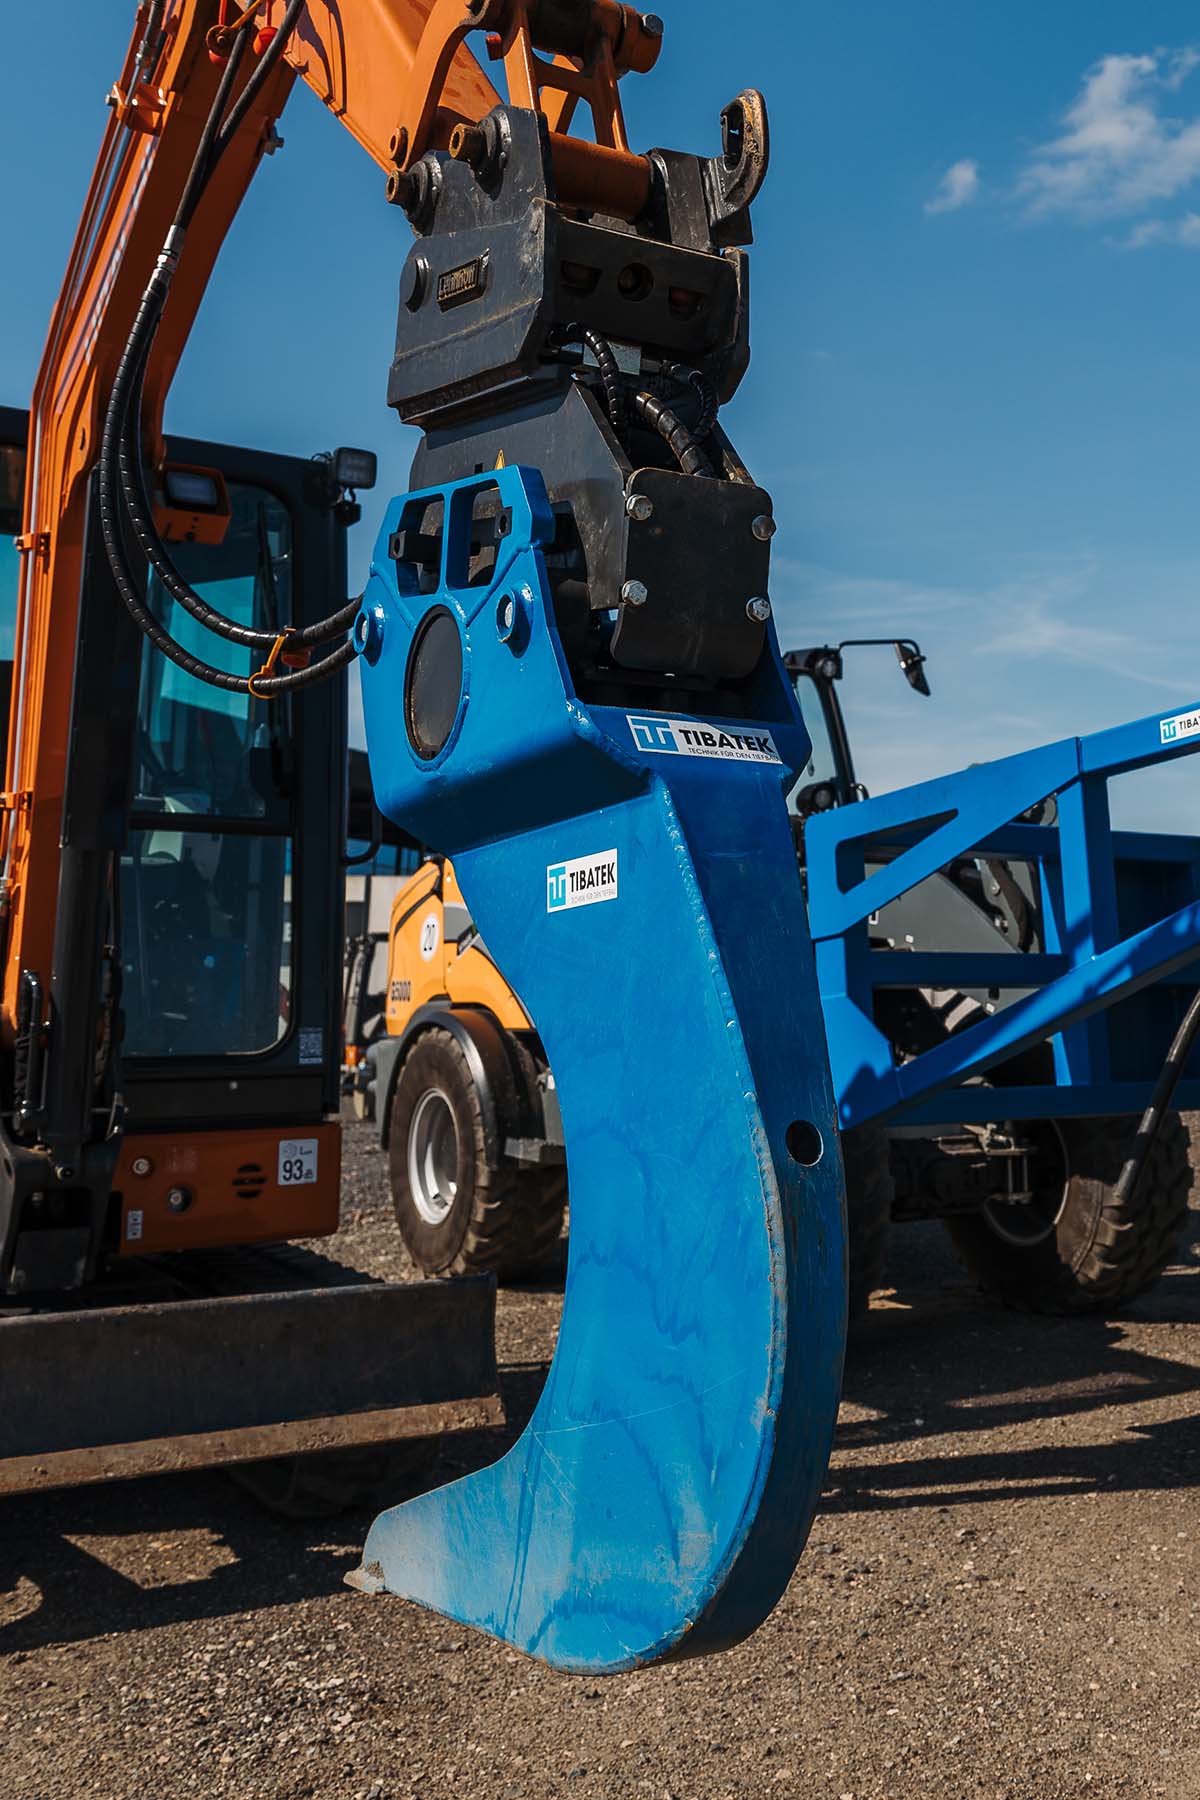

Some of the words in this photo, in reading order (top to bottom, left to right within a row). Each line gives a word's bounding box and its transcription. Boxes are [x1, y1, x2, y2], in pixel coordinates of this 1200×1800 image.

[1179, 716, 1200, 730] TIBA
[679, 729, 774, 753] TIBATEK
[688, 747, 719, 757] TECHNIK
[752, 753, 778, 762] TIEFBAU
[569, 862, 616, 893] TIBATEK
[283, 1159, 304, 1181] 93
